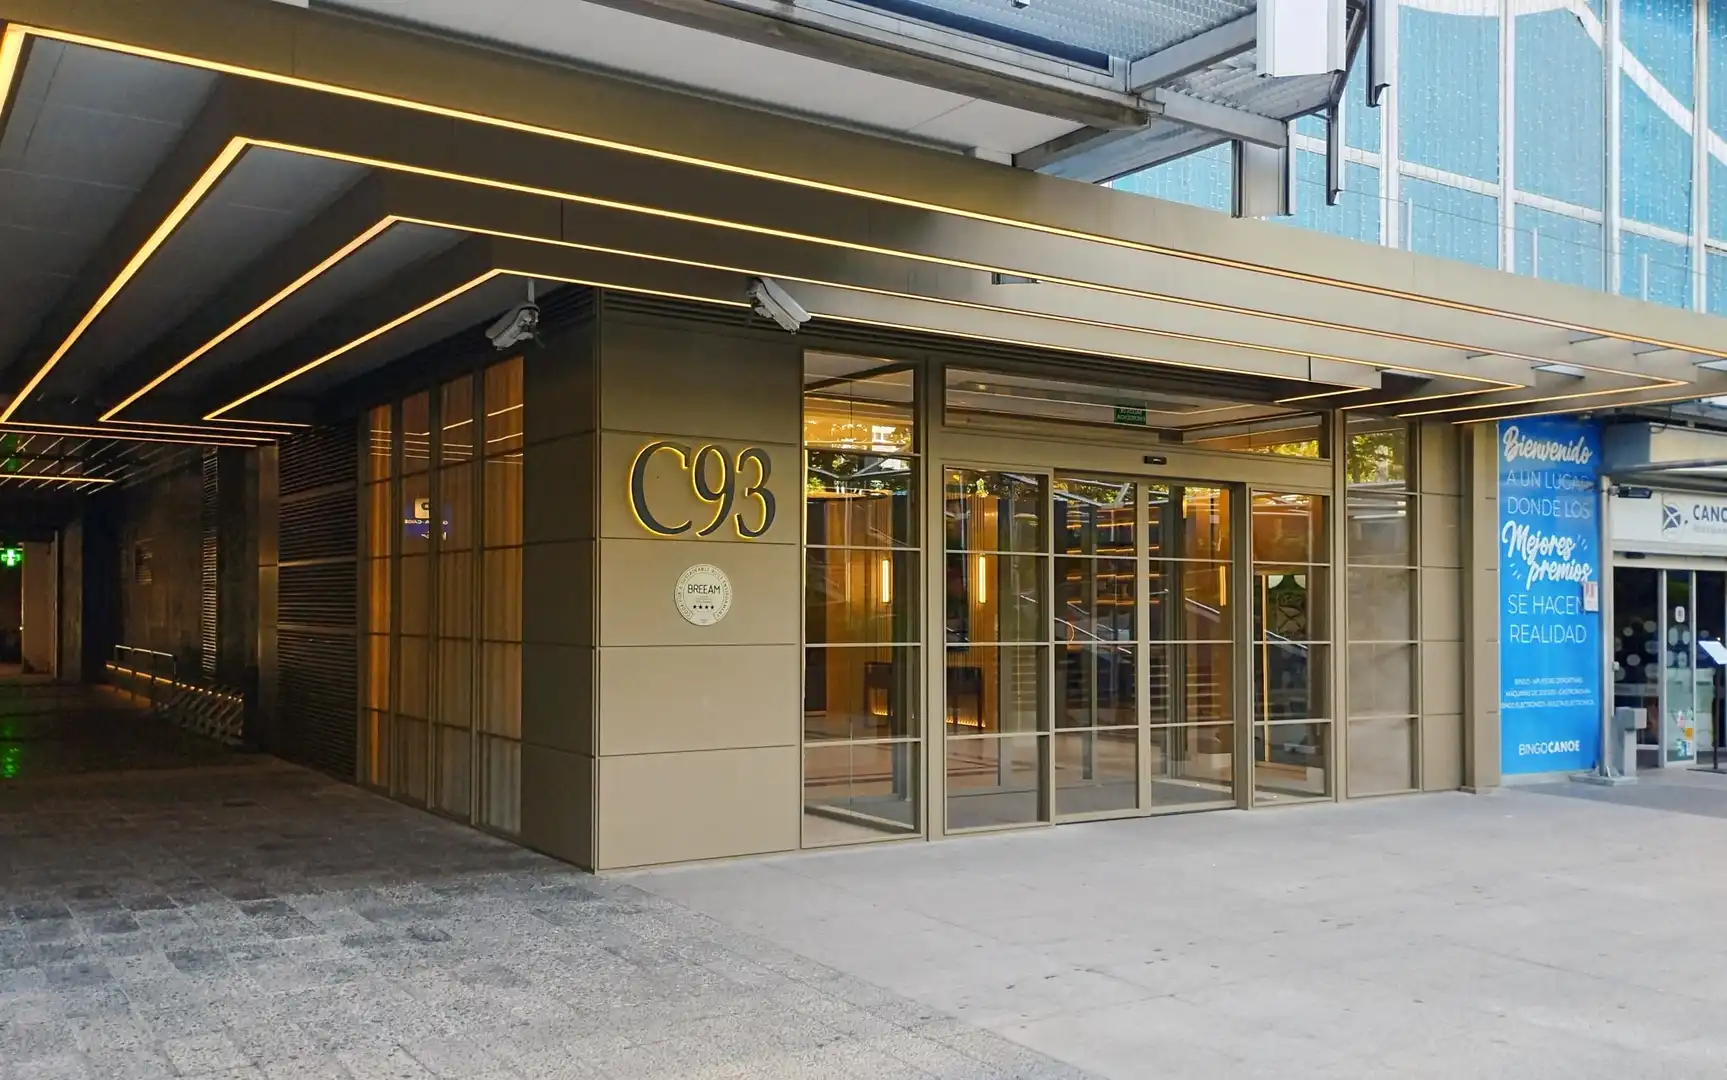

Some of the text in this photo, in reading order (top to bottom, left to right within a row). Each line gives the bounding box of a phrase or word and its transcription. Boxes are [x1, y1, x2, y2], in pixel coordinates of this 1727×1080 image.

[1503, 425, 1593, 464] Bienvenido
[1507, 469, 1516, 485] A
[1520, 470, 1541, 487] UN
[629, 440, 776, 538] C93
[1507, 496, 1591, 519] DONDE LOS
[1502, 521, 1576, 565] Mejores
[1526, 559, 1592, 591] premios
[687, 584, 721, 594] BREEAM
[1508, 594, 1528, 614] SE
[1510, 624, 1587, 643] REALIDAD
[1519, 740, 1580, 755] BINGOCANOE
